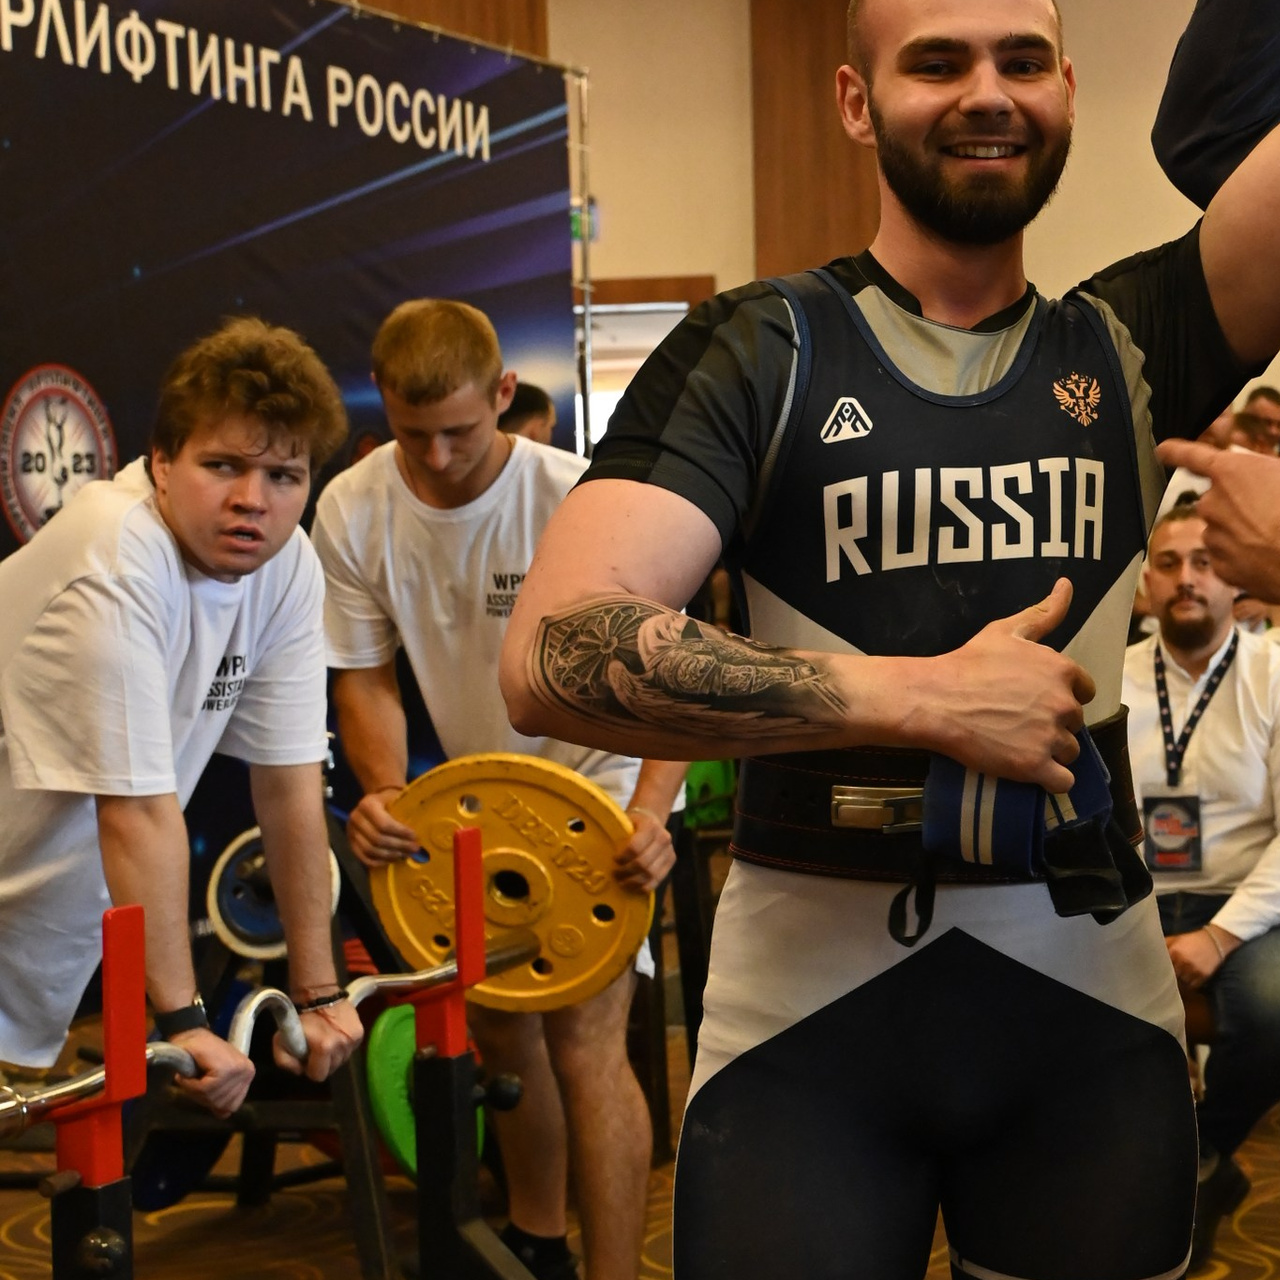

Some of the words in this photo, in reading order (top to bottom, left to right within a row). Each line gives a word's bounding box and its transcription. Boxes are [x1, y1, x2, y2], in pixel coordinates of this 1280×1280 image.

[327, 65, 491, 163] РОССИИ
[22, 451, 46, 473] 20
[72, 452, 96, 474] 23
[823, 457, 1105, 583] RUSSIA
